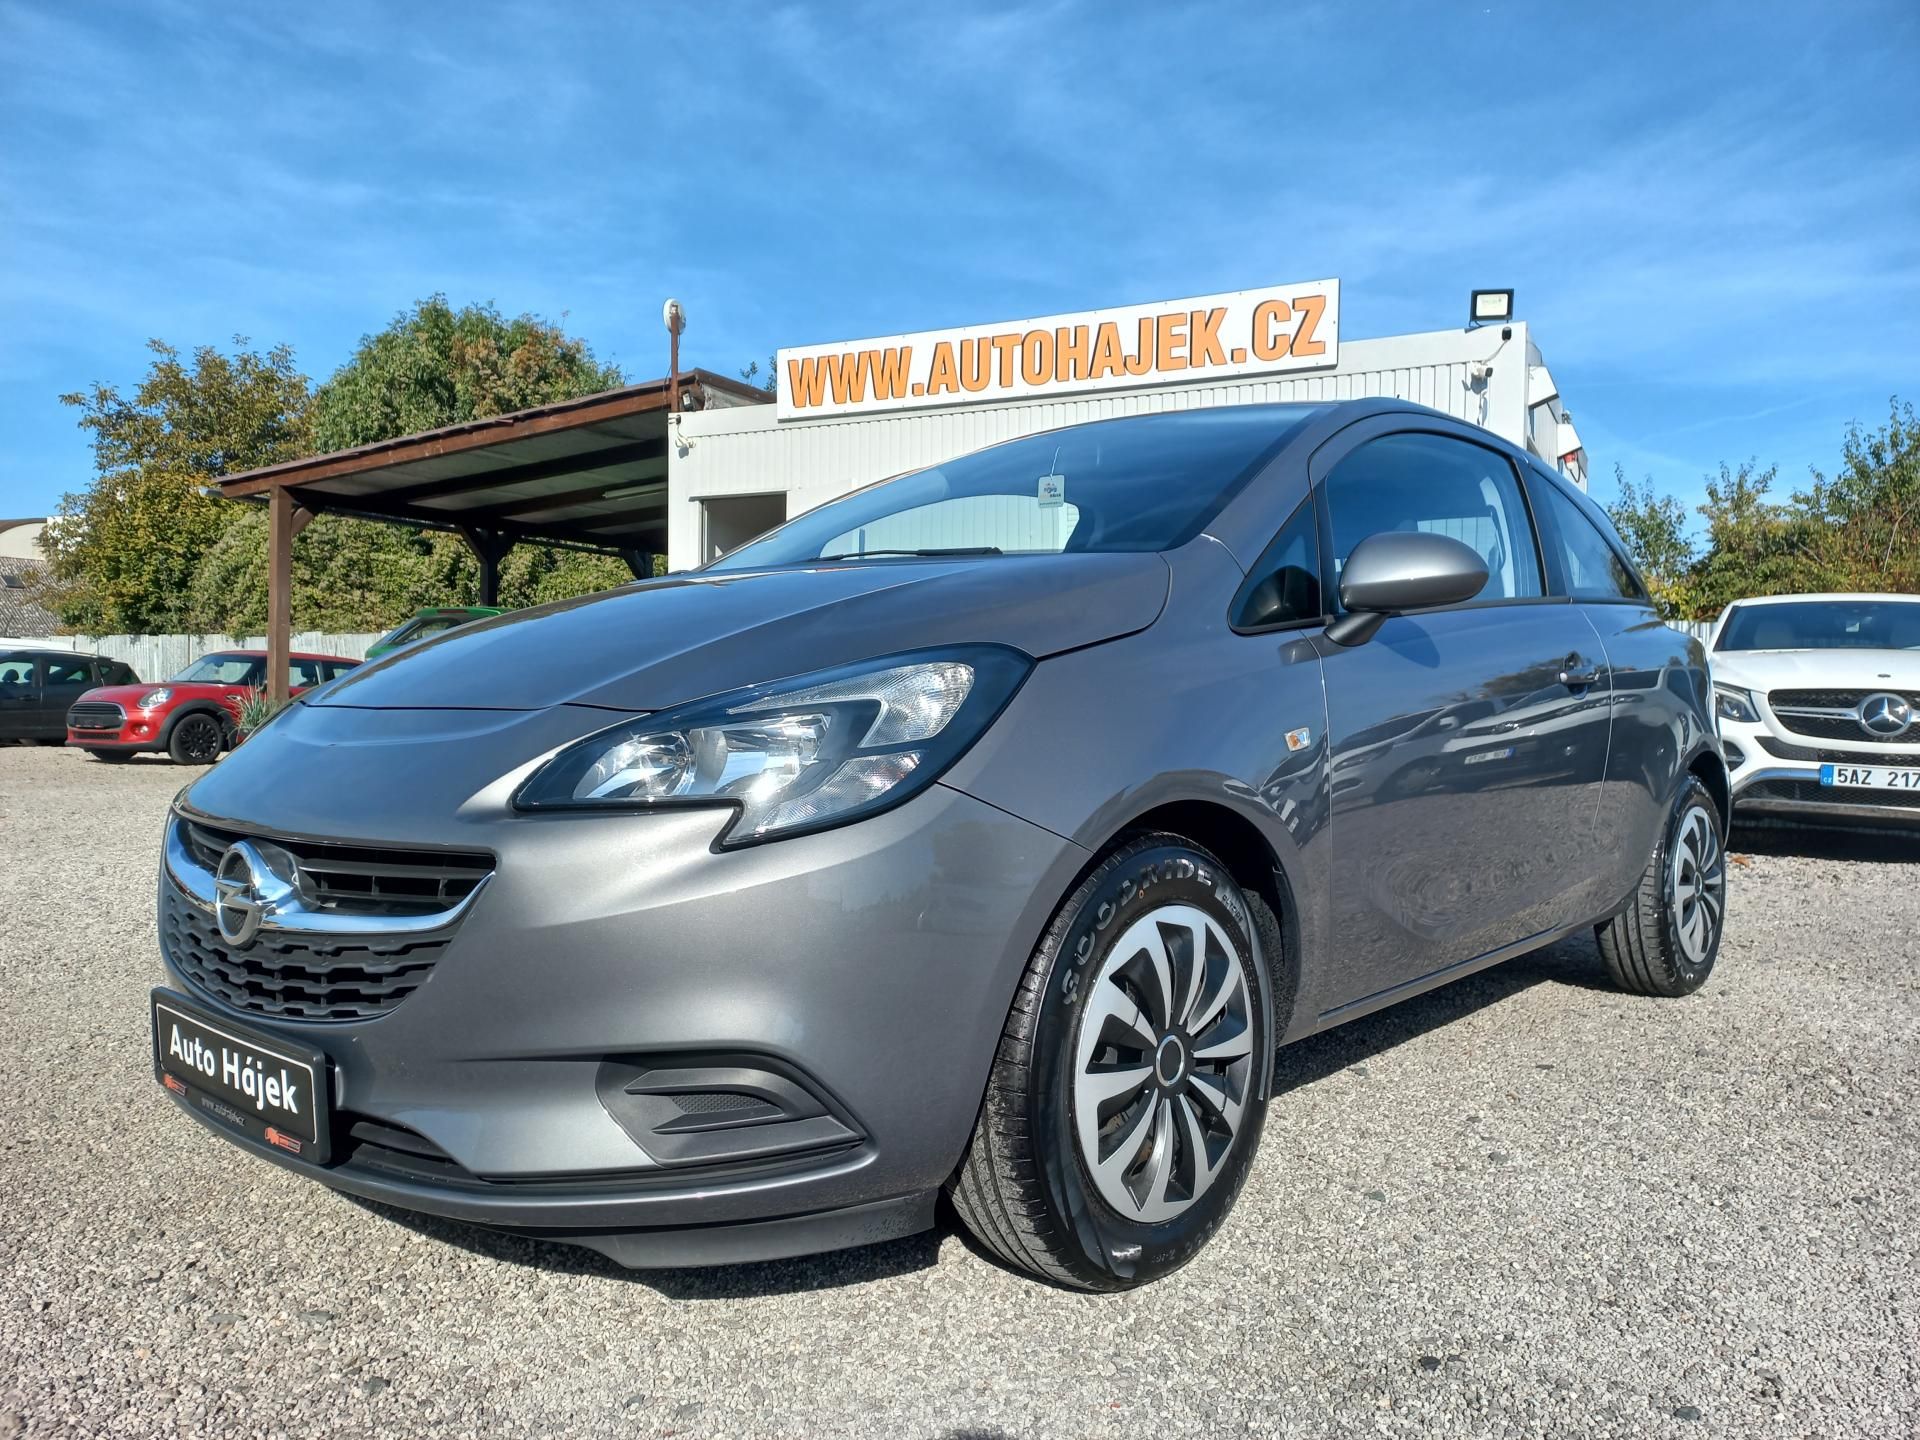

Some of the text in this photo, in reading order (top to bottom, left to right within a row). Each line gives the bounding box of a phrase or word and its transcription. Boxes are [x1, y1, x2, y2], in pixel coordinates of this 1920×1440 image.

[787, 295, 1327, 408] WWW.AUTOHAJEK.CZ
[1837, 768, 1920, 788] 5AZ 217
[169, 1024, 215, 1076] Auto
[222, 1048, 298, 1114] Hájek
